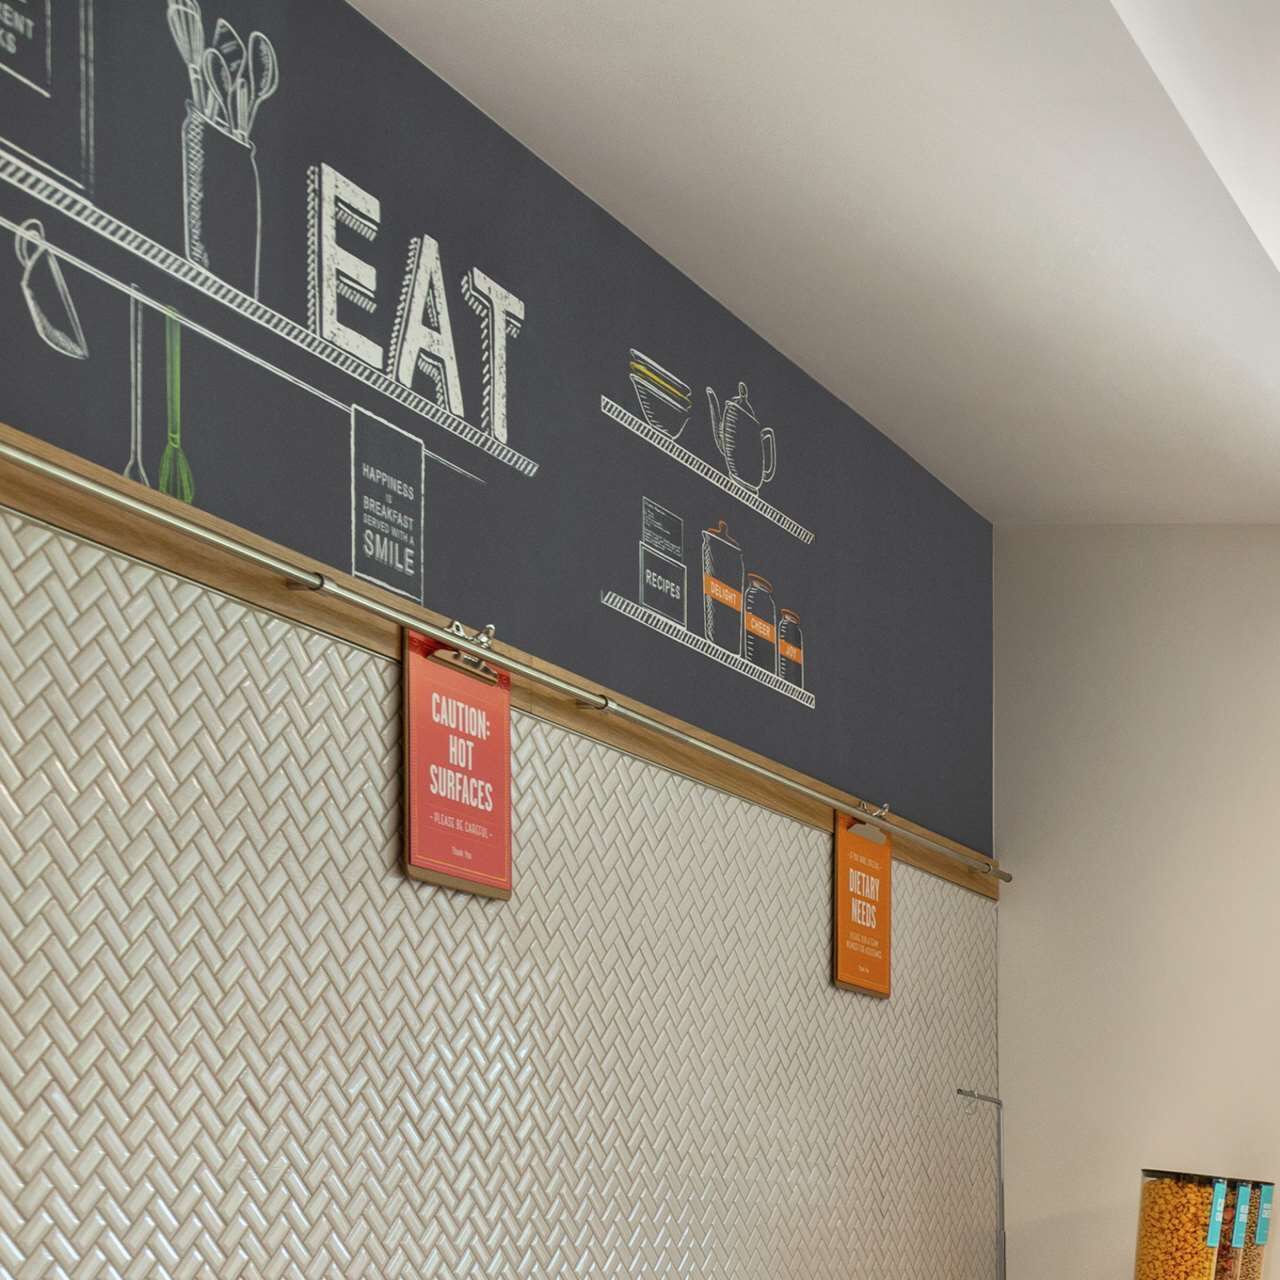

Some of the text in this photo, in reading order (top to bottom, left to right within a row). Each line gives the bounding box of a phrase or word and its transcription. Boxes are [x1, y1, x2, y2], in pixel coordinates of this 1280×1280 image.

[307, 162, 525, 444] EAT
[362, 462, 415, 500] HAPPINESS
[363, 495, 414, 531] BREAKFAST
[363, 512, 416, 546] SERVED WITH A
[363, 529, 415, 576] SMILE
[645, 568, 681, 600] RECIPES
[710, 580, 737, 605] DELIGHT
[431, 691, 491, 741] CAUTION:
[449, 734, 475, 771] HOT
[429, 763, 493, 812] SURFACES
[848, 868, 881, 901] DIETARY
[851, 897, 877, 929] NEEDS
